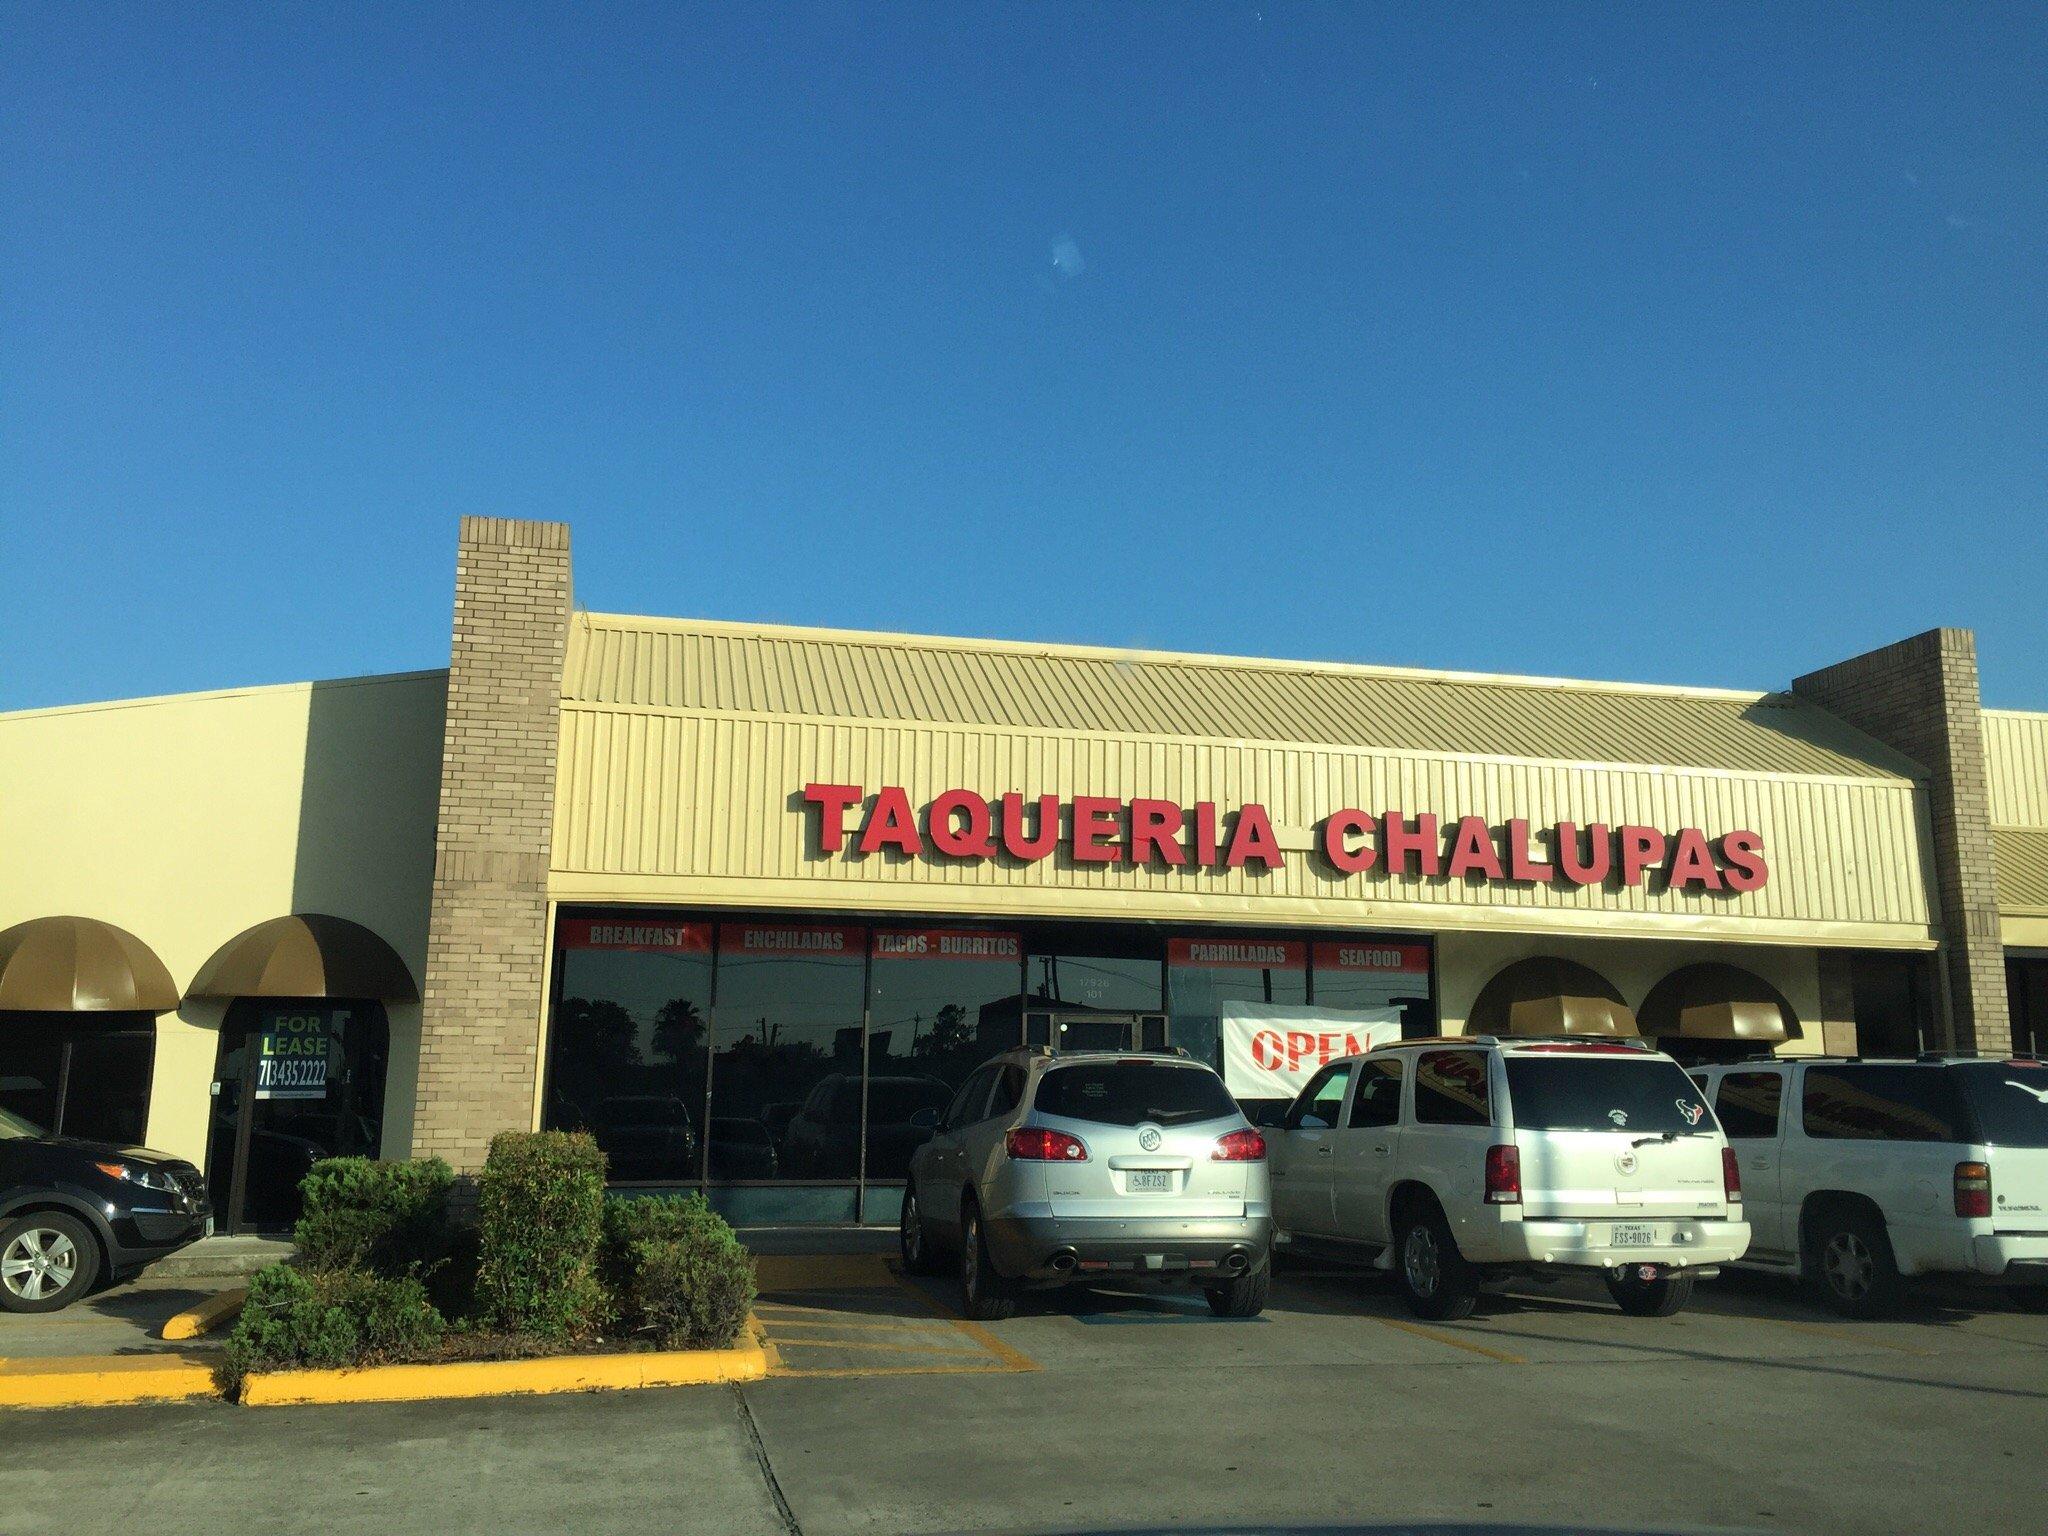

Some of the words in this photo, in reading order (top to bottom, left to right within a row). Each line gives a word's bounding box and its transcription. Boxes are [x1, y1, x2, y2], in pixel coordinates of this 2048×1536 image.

[804, 783, 1286, 868] TAQUERIA
[1325, 808, 1770, 893] CHALUPAS
[590, 926, 686, 946] BREAKFAST
[744, 930, 844, 950] ENCHILADAS
[877, 934, 928, 954] TACOS
[940, 936, 1018, 956] BURRITOS
[1190, 943, 1286, 964] PARRILLADAS
[1339, 948, 1401, 968] SEAFOOD
[275, 1016, 321, 1033] FOR
[262, 1036, 328, 1056] LEASE
[259, 1060, 326, 1086] 713.435.2222
